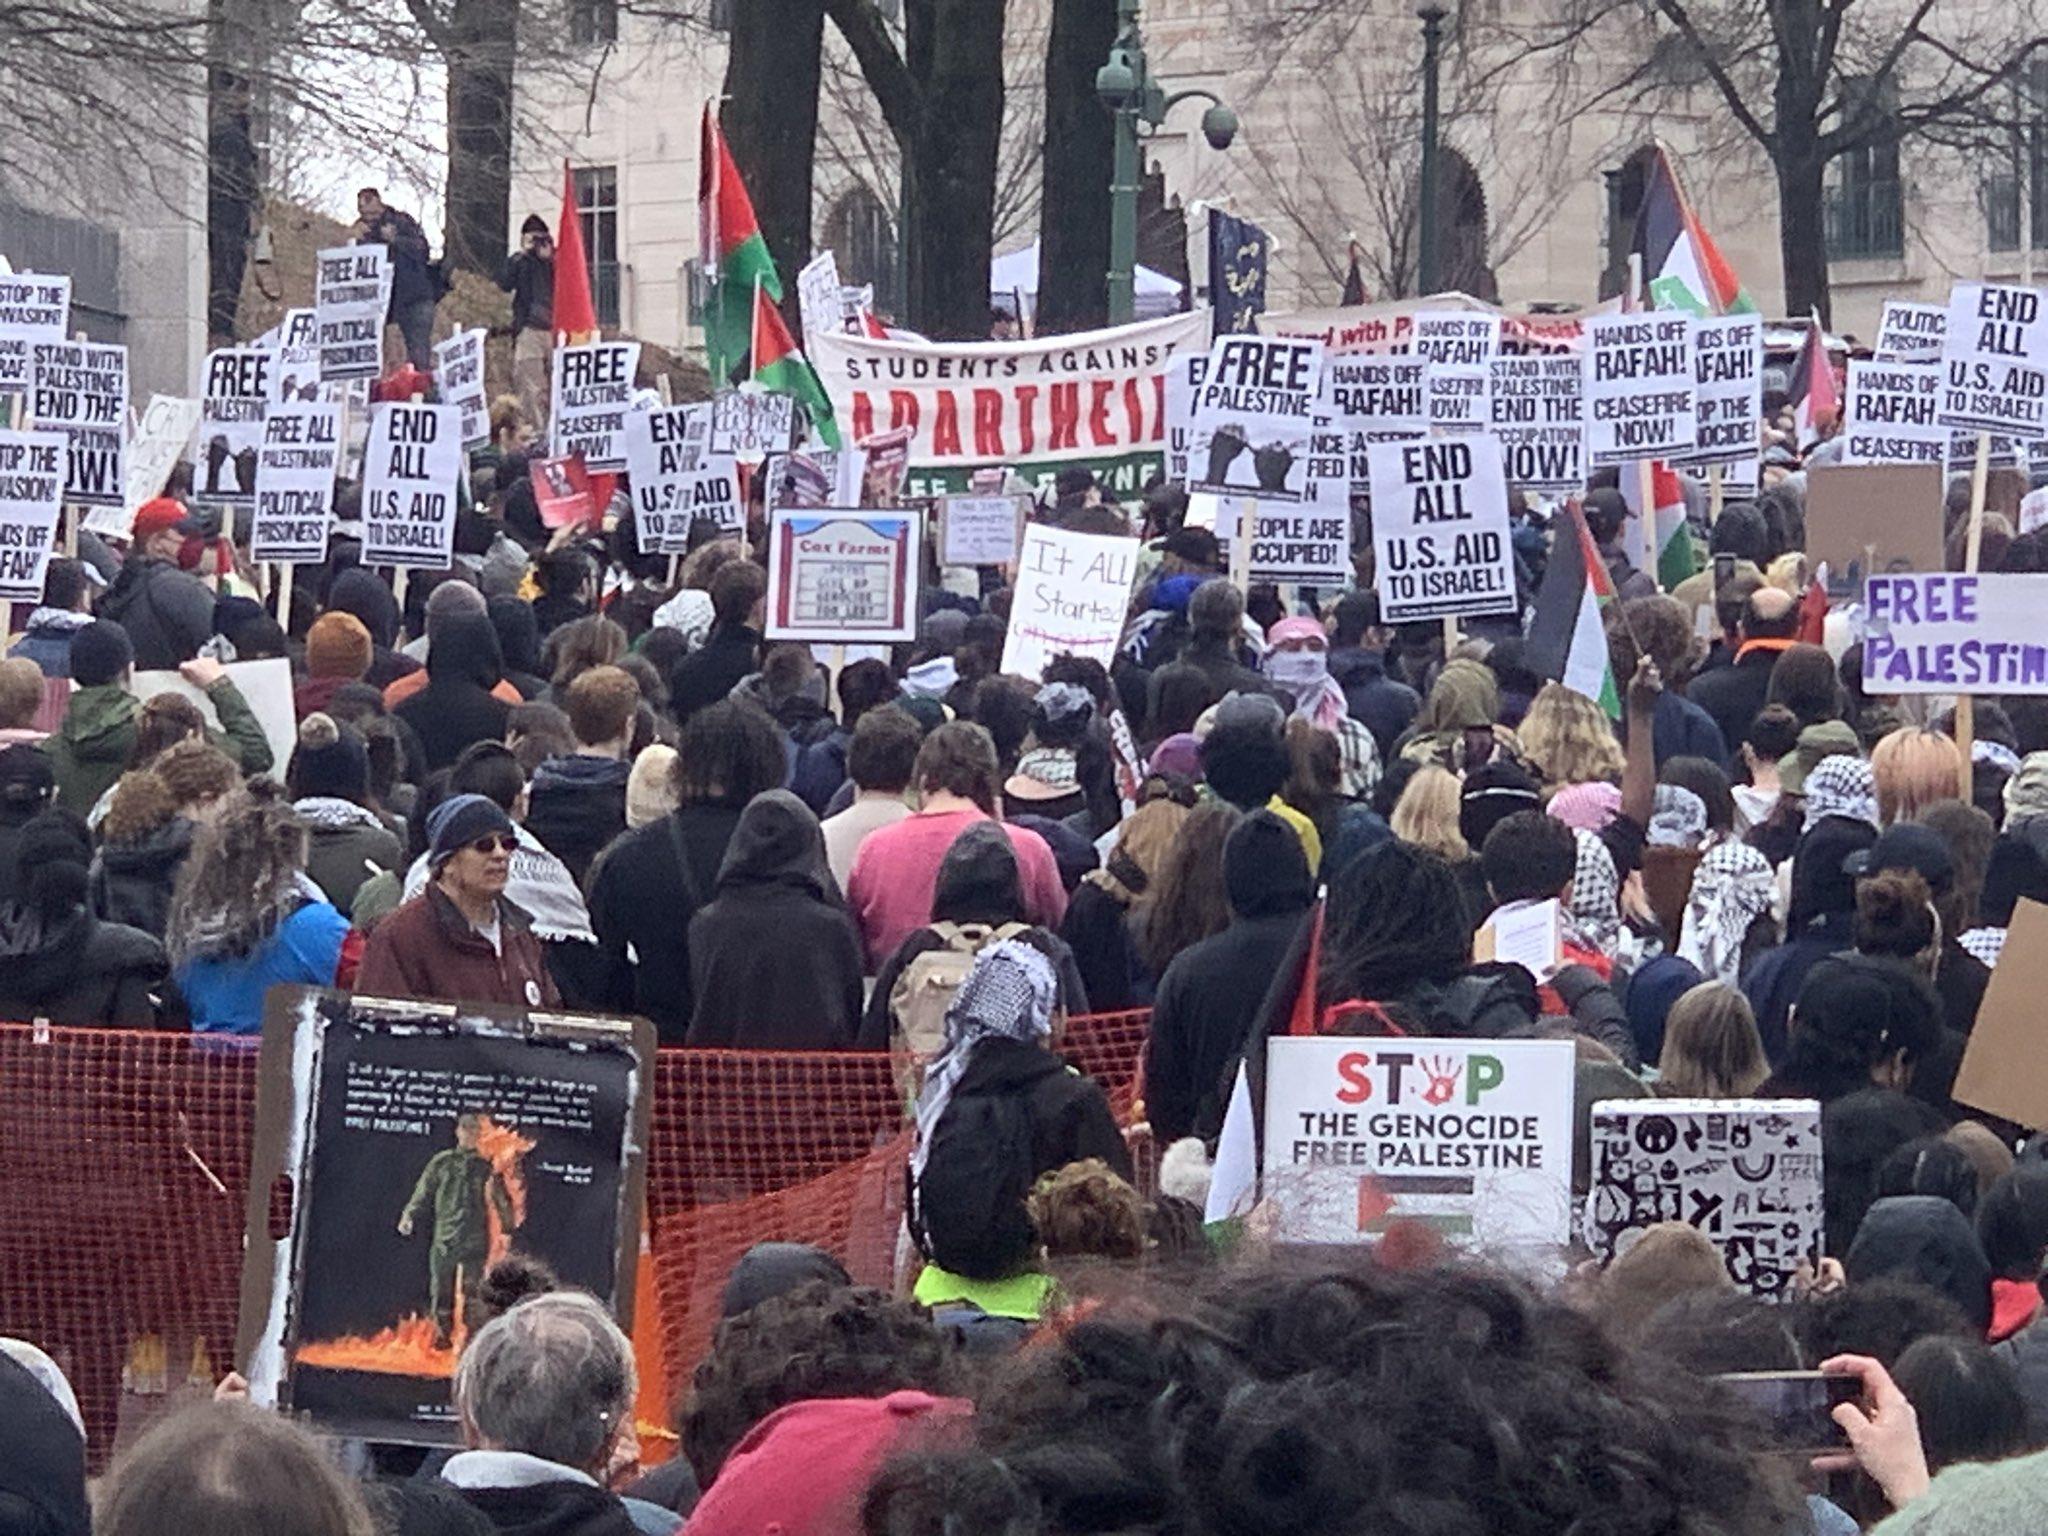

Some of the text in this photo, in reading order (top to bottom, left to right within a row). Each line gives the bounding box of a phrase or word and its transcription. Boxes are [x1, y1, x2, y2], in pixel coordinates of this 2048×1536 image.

[355, 256, 379, 279] ALL
[37, 286, 64, 305] THE
[1977, 288, 2038, 325] END
[321, 318, 377, 344] POLITICAL
[1341, 320, 1387, 345] with
[1418, 320, 1492, 338] HANDS OFF
[1594, 321, 1687, 347] HANDS OFF
[1727, 325, 1754, 345] OFF
[1977, 322, 2029, 358] ALL
[34, 344, 123, 370] STAND WITH
[847, 356, 1018, 380] STUDENTS
[1039, 343, 1177, 373] AGAINST
[1216, 341, 1312, 391] FREE
[1418, 340, 1490, 364] RAFAH!
[1596, 345, 1687, 381] RAFAH!
[35, 366, 123, 394] PALESTINE!
[208, 353, 271, 397] FREE
[562, 347, 628, 388] FREE
[1333, 365, 1422, 384] HANDS OFF
[1490, 360, 1581, 377] STAND WITH
[1950, 360, 2045, 398] U.S. AID
[1490, 379, 1582, 397] PALESTINE!
[1856, 371, 1914, 394] HANDS
[35, 389, 78, 419] END
[84, 394, 123, 422] THE
[1205, 385, 1312, 416] PALESTINE
[1334, 388, 1422, 416] RAFAH!
[1492, 399, 1584, 422] END THE
[1594, 391, 1692, 420] CEASEFIRE
[1721, 396, 1751, 418] THE
[1945, 390, 2043, 422] TO ISRAEL!
[266, 414, 335, 443] FREE ALL
[388, 408, 437, 444] END
[1615, 418, 1675, 447] NOW!
[30, 445, 59, 472] THE
[388, 446, 430, 479] ALL
[1402, 443, 1472, 483] END
[259, 489, 325, 516] POLITICAL
[694, 478, 731, 506] AID
[1413, 484, 1472, 524] ALL
[371, 491, 446, 522] U.S. AID
[26, 525, 49, 547] OFF
[368, 522, 444, 548] TO ISRAEL!
[643, 514, 664, 534] TO
[1308, 519, 1344, 540] ARE
[800, 540, 832, 553] Cox
[1250, 544, 1337, 564] CCUPIED!
[1387, 532, 1501, 571] U.S. AID
[1027, 539, 1129, 586] It ALL
[1388, 567, 1506, 600] TO ISRAEL!
[1868, 577, 1979, 625] FREE
[1300, 1112, 1539, 1140] THE GENOCIDE
[1294, 1141, 1543, 1169] FREE PALESTINE
